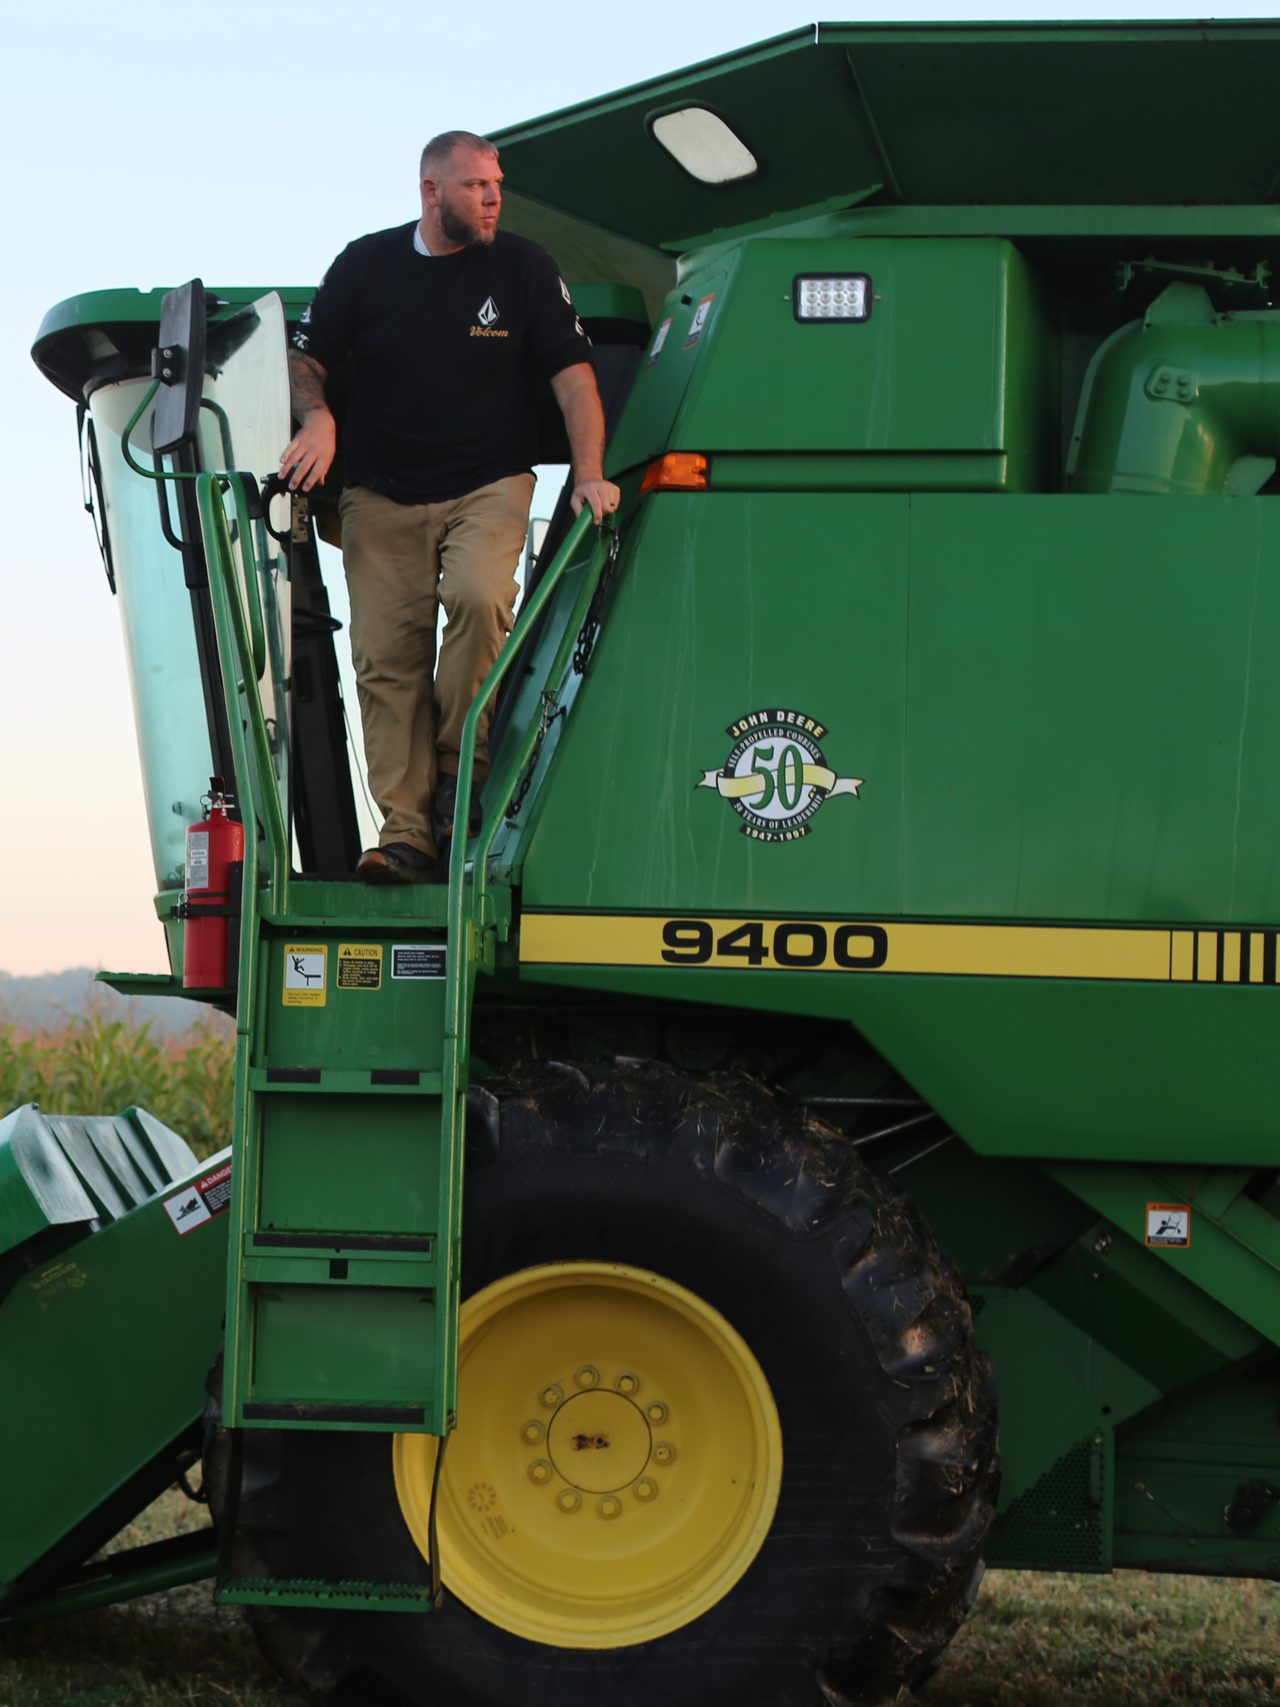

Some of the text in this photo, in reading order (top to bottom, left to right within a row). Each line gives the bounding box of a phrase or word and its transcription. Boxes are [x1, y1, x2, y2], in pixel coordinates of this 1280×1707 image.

[470, 325, 509, 337] Volcom
[732, 711, 824, 737] JOHN DEERE
[727, 728, 821, 768] SELF-PROPELLED COMBINES
[749, 744, 804, 810] 50
[742, 811, 766, 828] YEARS
[769, 820, 780, 830] OF
[782, 794, 823, 828] LEADERSHIP
[354, 948, 378, 957] CAUTION
[661, 919, 889, 969] 9400
